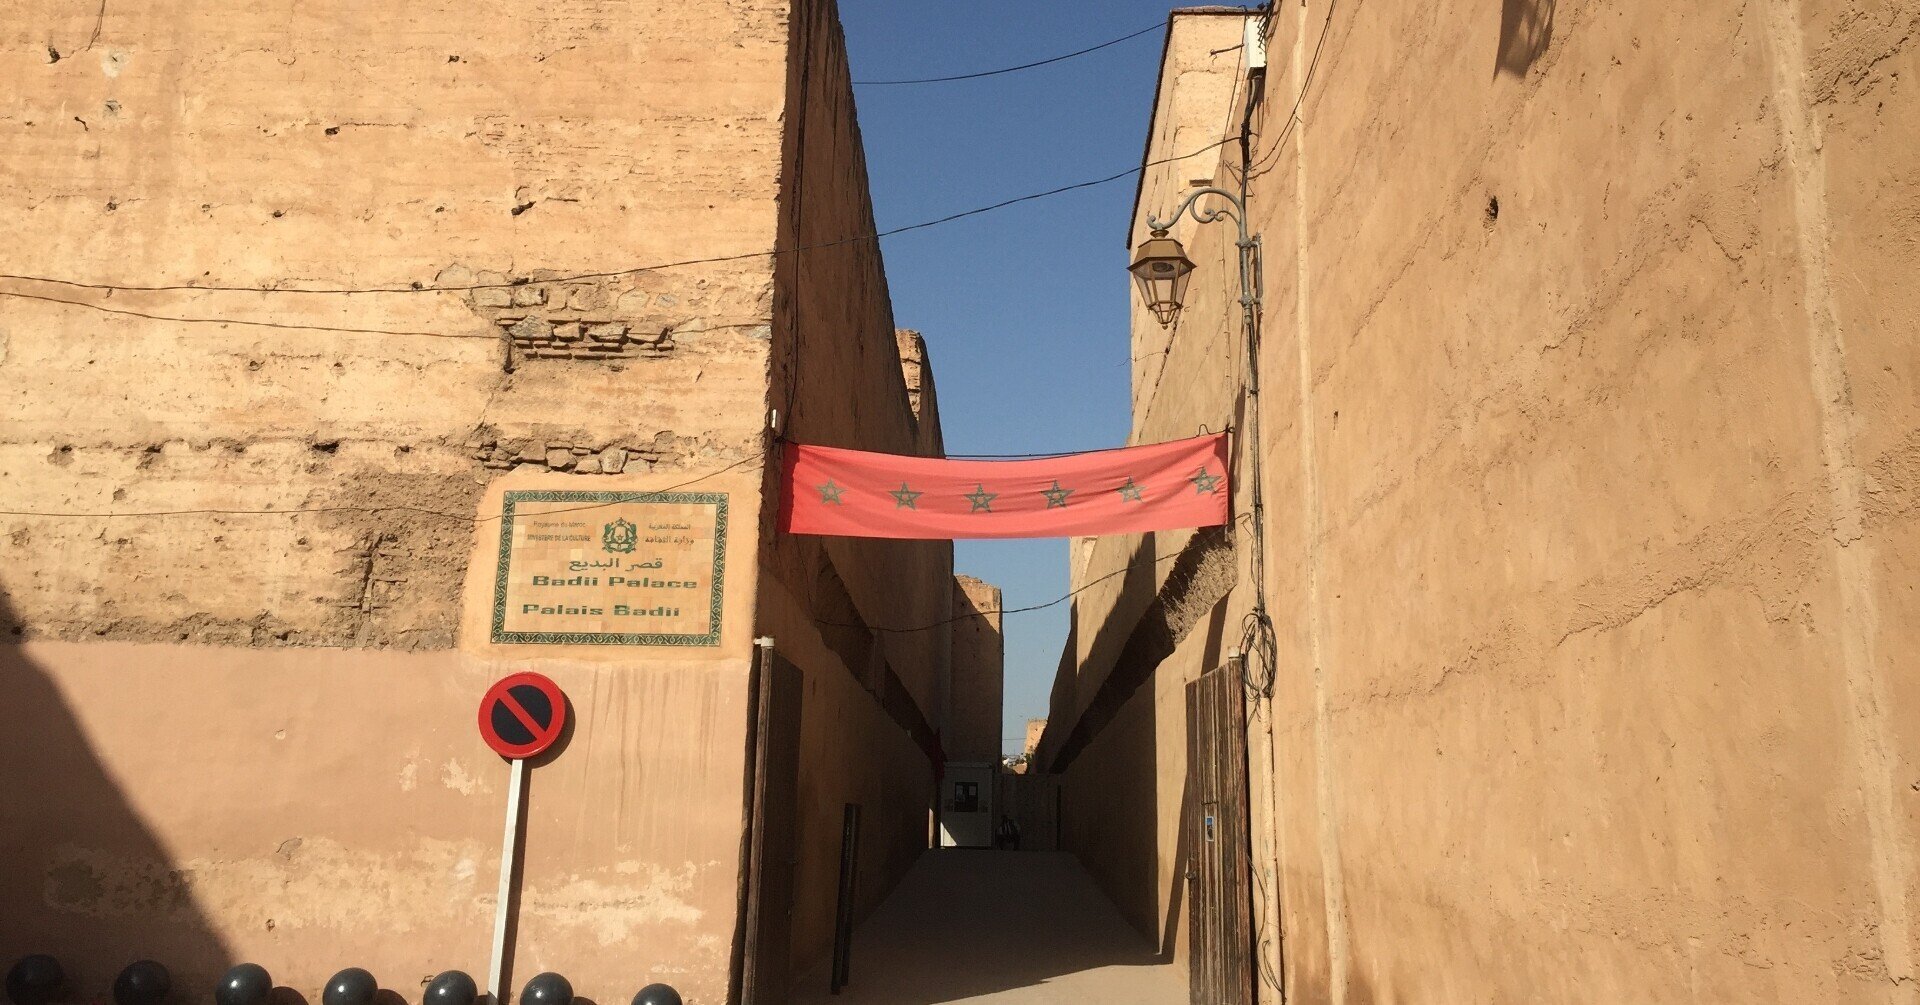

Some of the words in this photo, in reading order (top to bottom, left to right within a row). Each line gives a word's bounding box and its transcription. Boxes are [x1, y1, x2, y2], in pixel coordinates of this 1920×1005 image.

[569, 558, 620, 571] البديع
[625, 558, 663, 571] قصر
[532, 575, 598, 587] Badii
[608, 576, 697, 589] Palace
[522, 604, 603, 616] Palais
[614, 604, 680, 617] Badii
